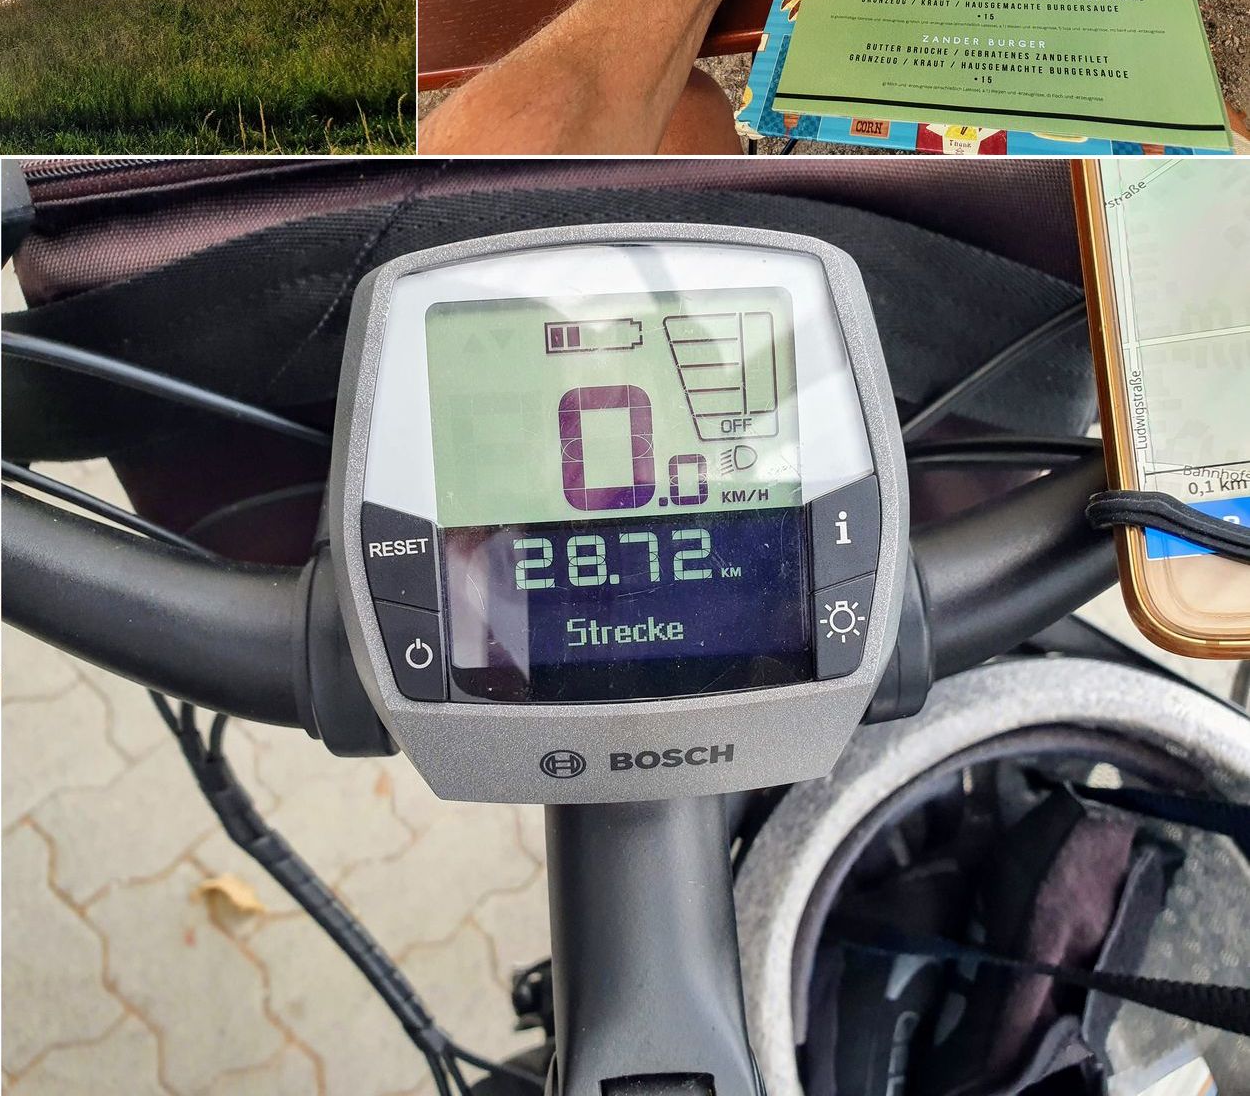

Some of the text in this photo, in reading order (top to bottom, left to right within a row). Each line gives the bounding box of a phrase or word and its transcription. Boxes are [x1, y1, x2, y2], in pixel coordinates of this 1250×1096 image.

[920, 0, 950, 7] KRAUT
[965, 1, 1041, 11] HAUSGEMACHTE
[1046, 4, 1119, 13] BURGERSAUCE
[922, 35, 1046, 49] ZANDER BURGER
[866, 43, 902, 52] BUTTER
[906, 46, 949, 56] BRIOCHE
[964, 49, 1030, 60] GEBRATENES
[1036, 53, 1109, 64] ZANDERFILET
[849, 53, 898, 65] GRÜNZEUG
[913, 58, 945, 68] KRAUT
[961, 61, 1043, 74] HAUSGEMACHTE
[1049, 66, 1129, 79] BURGERSAUCE
[981, 76, 993, 84] 15
[855, 120, 884, 135] CORN
[1103, 181, 1147, 209] straße
[1129, 370, 1148, 450] Ludwigstraße
[720, 418, 752, 433] OFF
[721, 488, 769, 503] KM/H
[1188, 477, 1247, 496] 0,1 km
[369, 538, 429, 558] RESET
[513, 528, 742, 590] 28.72 KM
[566, 617, 684, 647] Strecke
[610, 744, 734, 771] BOSCH
